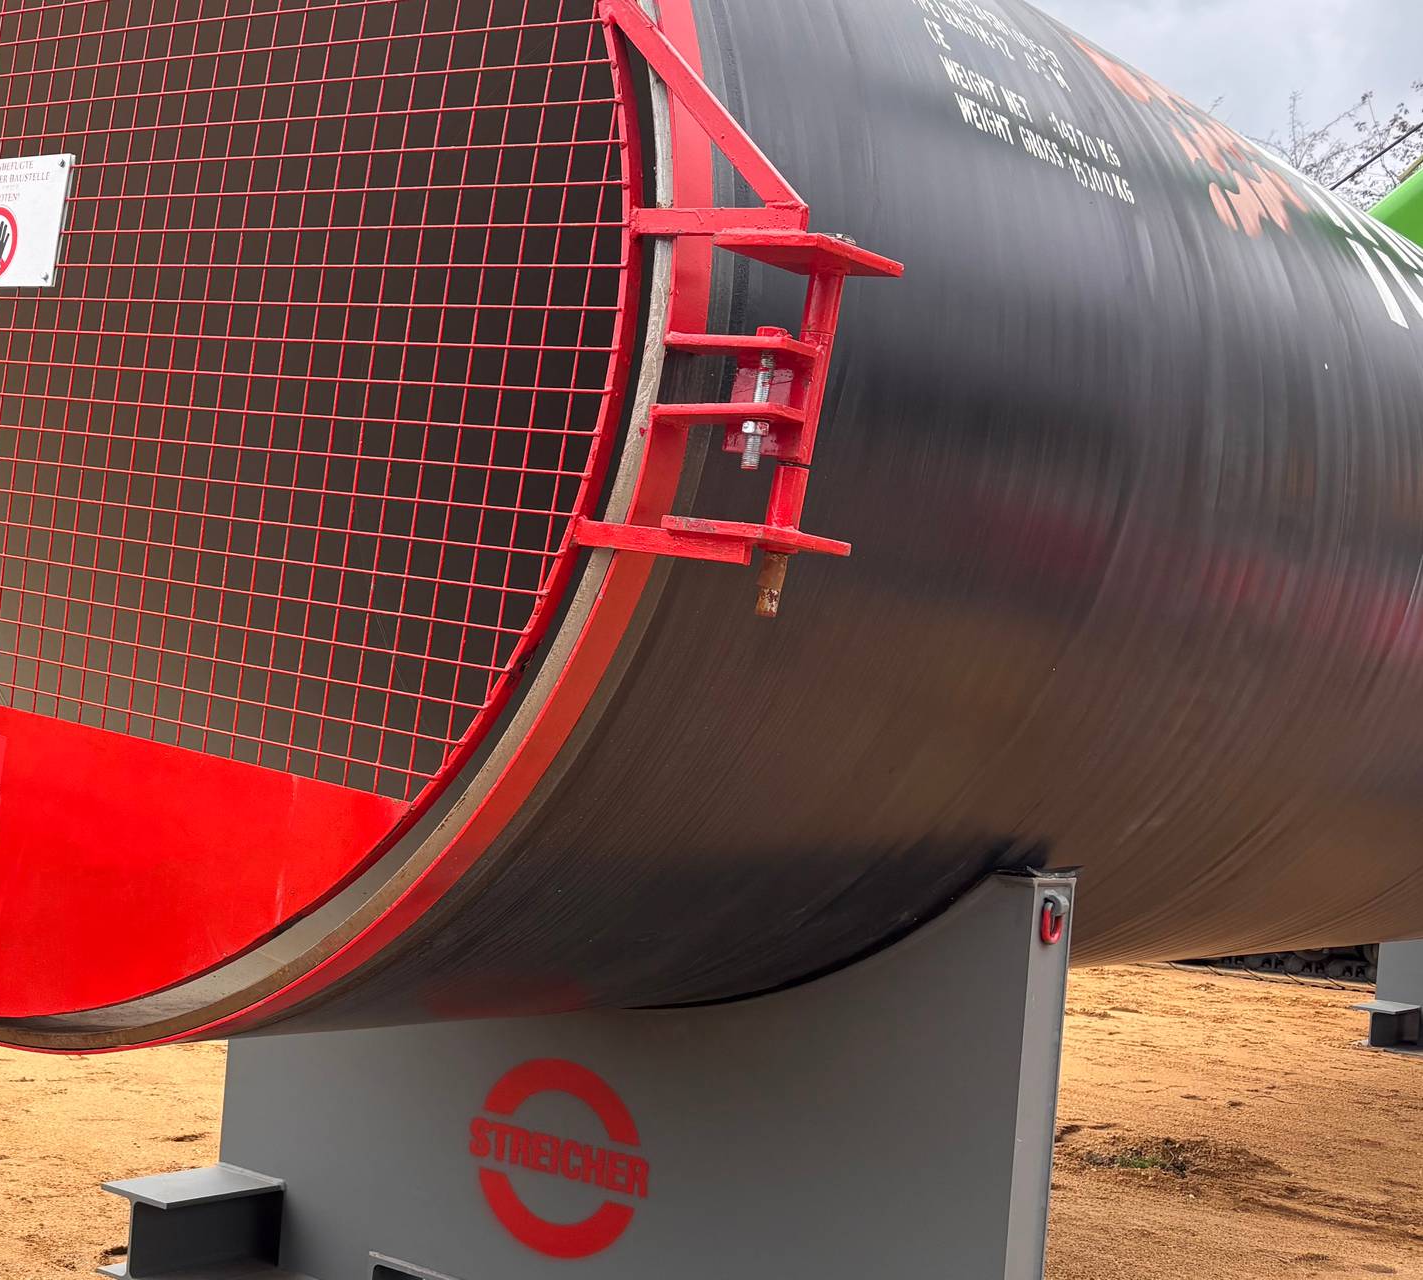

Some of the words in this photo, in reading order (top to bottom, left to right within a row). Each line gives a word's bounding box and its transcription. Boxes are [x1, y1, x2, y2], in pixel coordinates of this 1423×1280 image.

[938, 54, 1000, 107] WEIGHT
[1000, 85, 1033, 123] NET
[954, 92, 1014, 145] WEIGHT
[1111, 173, 1135, 204] KG
[468, 1117, 650, 1200] STREICHER
